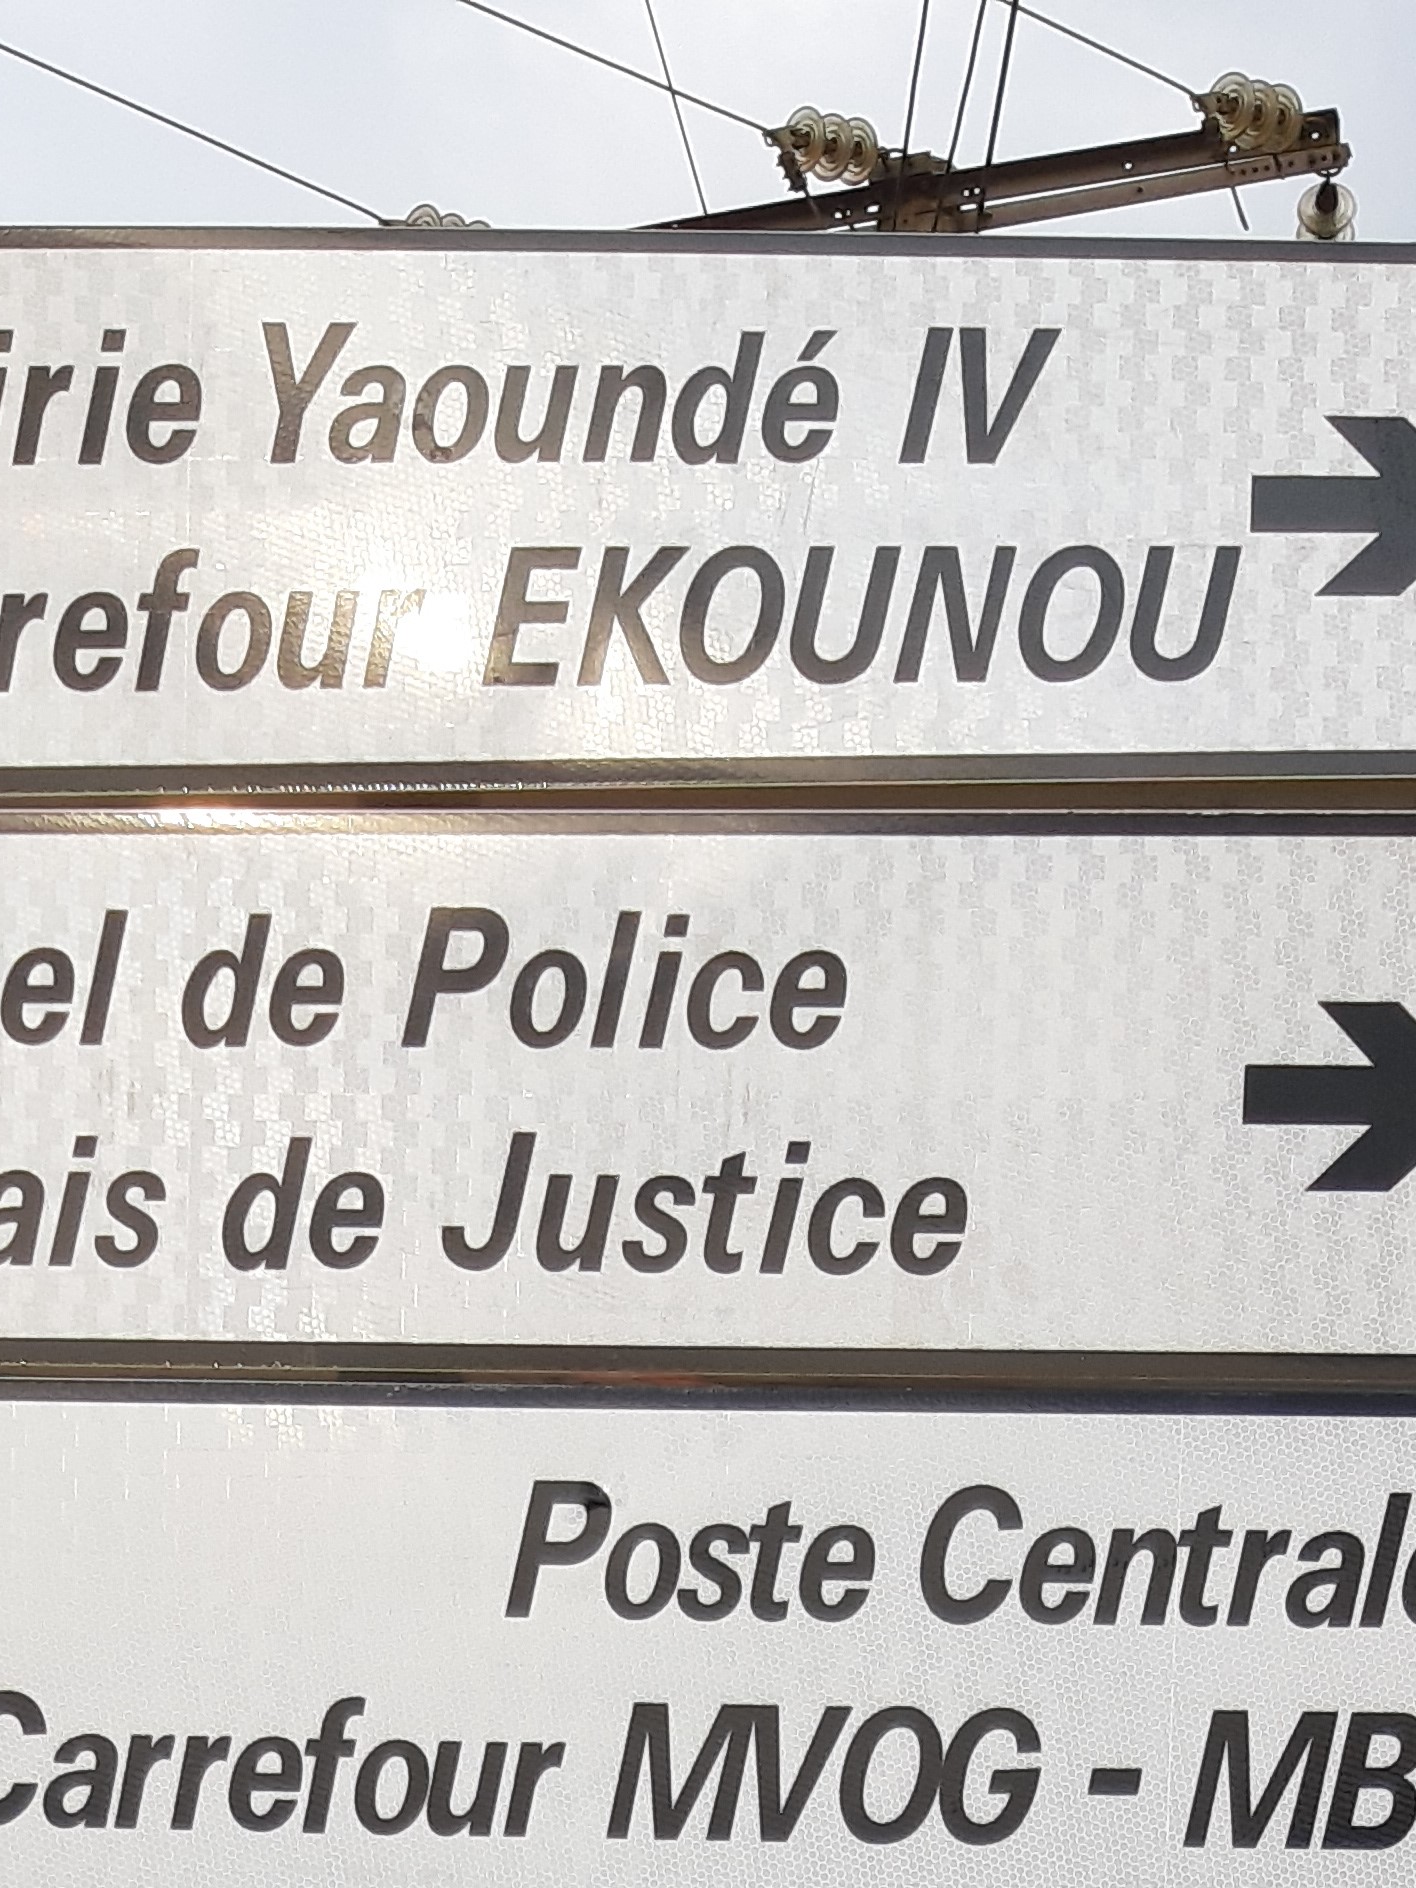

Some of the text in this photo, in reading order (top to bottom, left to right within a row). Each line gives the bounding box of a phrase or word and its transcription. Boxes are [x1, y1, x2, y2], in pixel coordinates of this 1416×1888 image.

[258, 324, 842, 466] Yaoundé
[901, 327, 1059, 463] IV
[482, 544, 1243, 688] EKOUNOU
[181, 913, 344, 1048] de
[402, 909, 847, 1050] Police
[221, 1137, 384, 1271] de
[441, 1137, 968, 1275] Justice
[506, 1480, 876, 1622] Poste
[606, 1701, 1041, 1846] MVOG
[1087, 1766, 1144, 1796] -
